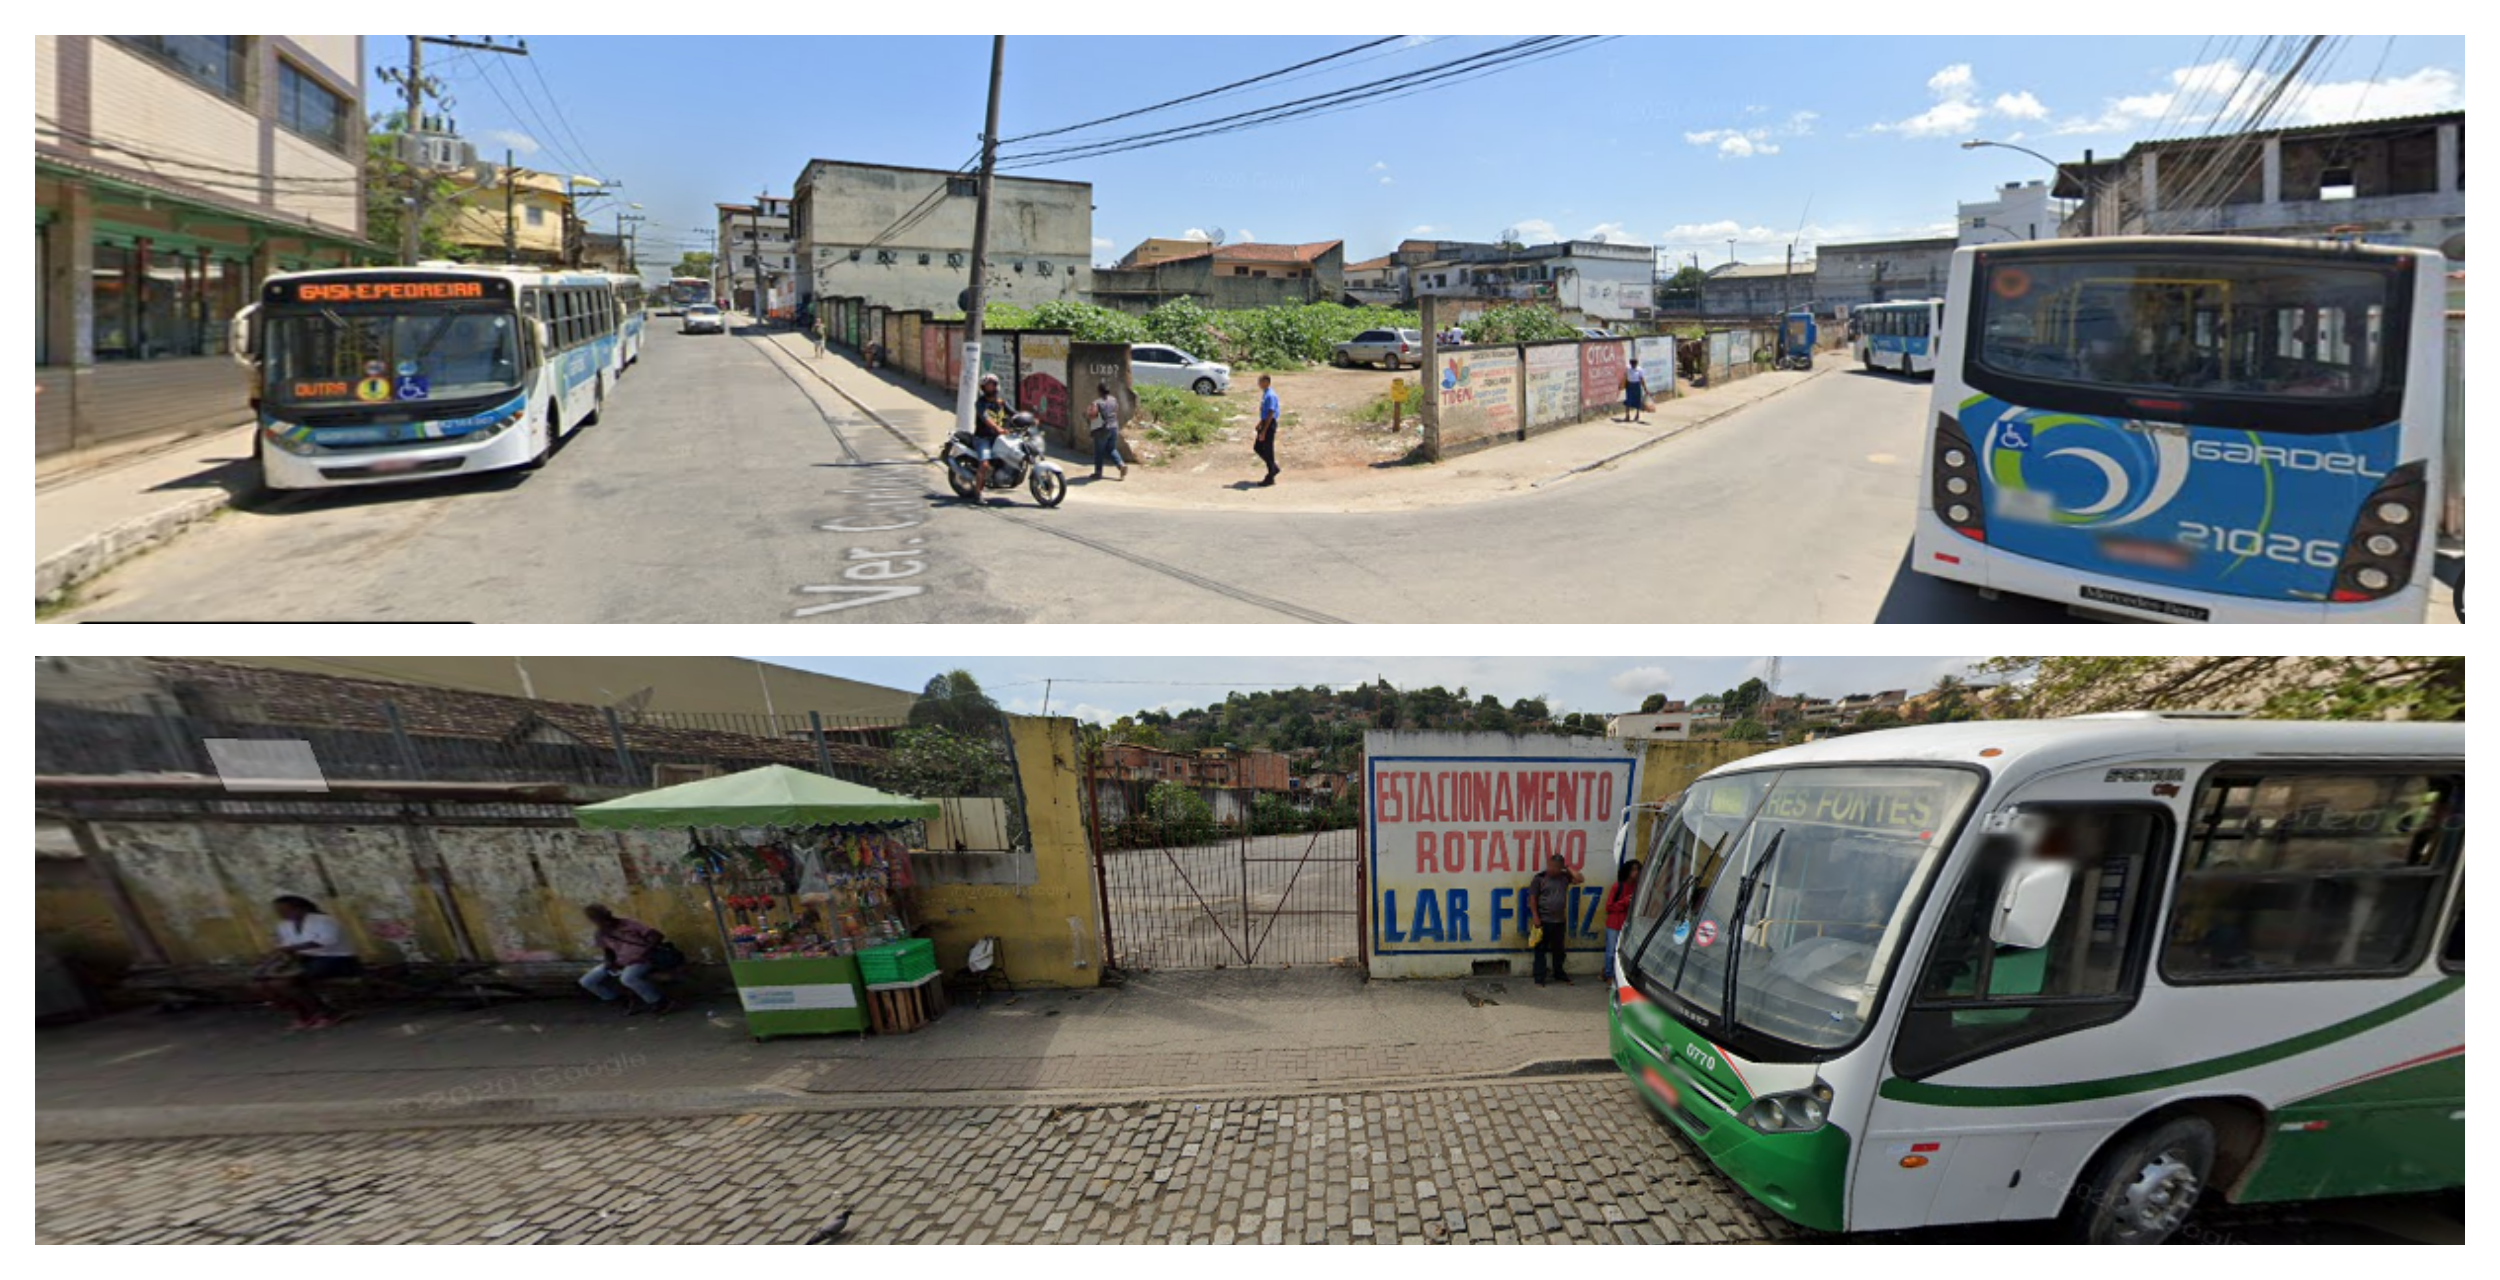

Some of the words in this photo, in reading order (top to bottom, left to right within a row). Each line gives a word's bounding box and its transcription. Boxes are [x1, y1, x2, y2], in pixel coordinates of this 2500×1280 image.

[2177, 521, 2340, 568] 21026
[1376, 771, 1613, 823] ESTACIONAMENTO
[1815, 786, 1932, 828] FONTES
[1416, 829, 1587, 874] ROTATIVO
[1384, 887, 1472, 944] LAR
[1686, 1043, 1716, 1072] 0770
